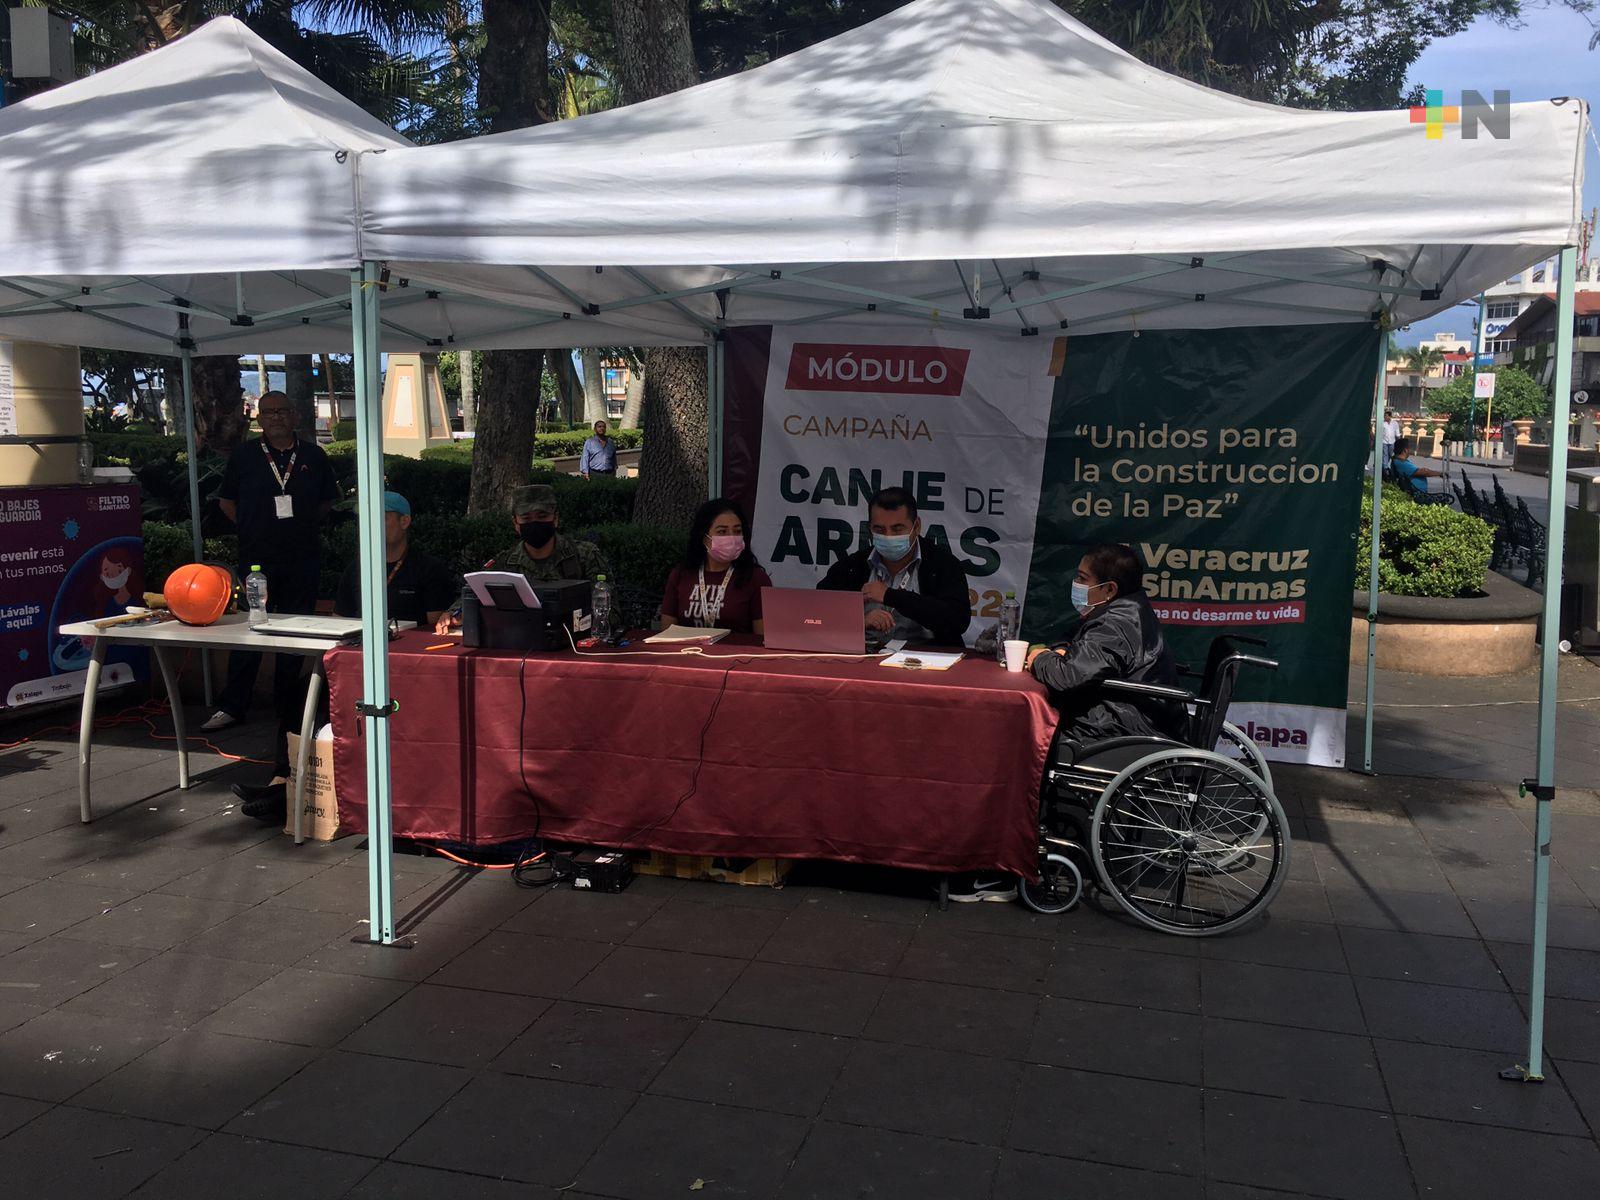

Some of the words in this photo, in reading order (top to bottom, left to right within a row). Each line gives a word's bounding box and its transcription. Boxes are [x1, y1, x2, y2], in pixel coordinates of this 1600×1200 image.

[808, 352, 947, 384] MÓDULO
[784, 414, 933, 441] CAMPAÑA
[1219, 427, 1297, 453] para
[1074, 457, 1100, 483] la
[1111, 456, 1338, 484] Construccion
[7, 499, 40, 512] BAJES
[99, 495, 130, 505] FILTRO
[965, 487, 1005, 515] DE
[1071, 491, 1112, 517] de
[1123, 492, 1149, 517] la
[41, 546, 65, 559] está
[1141, 543, 1310, 572] Veracruz
[5, 568, 24, 579] tus
[27, 563, 67, 577] manos.
[1142, 571, 1306, 601] SinArmas
[6, 616, 33, 629] aquí!
[1172, 610, 1190, 619] no
[1192, 609, 1253, 621] desarme
[1256, 609, 1270, 620] tu
[1273, 606, 1300, 619] vida
